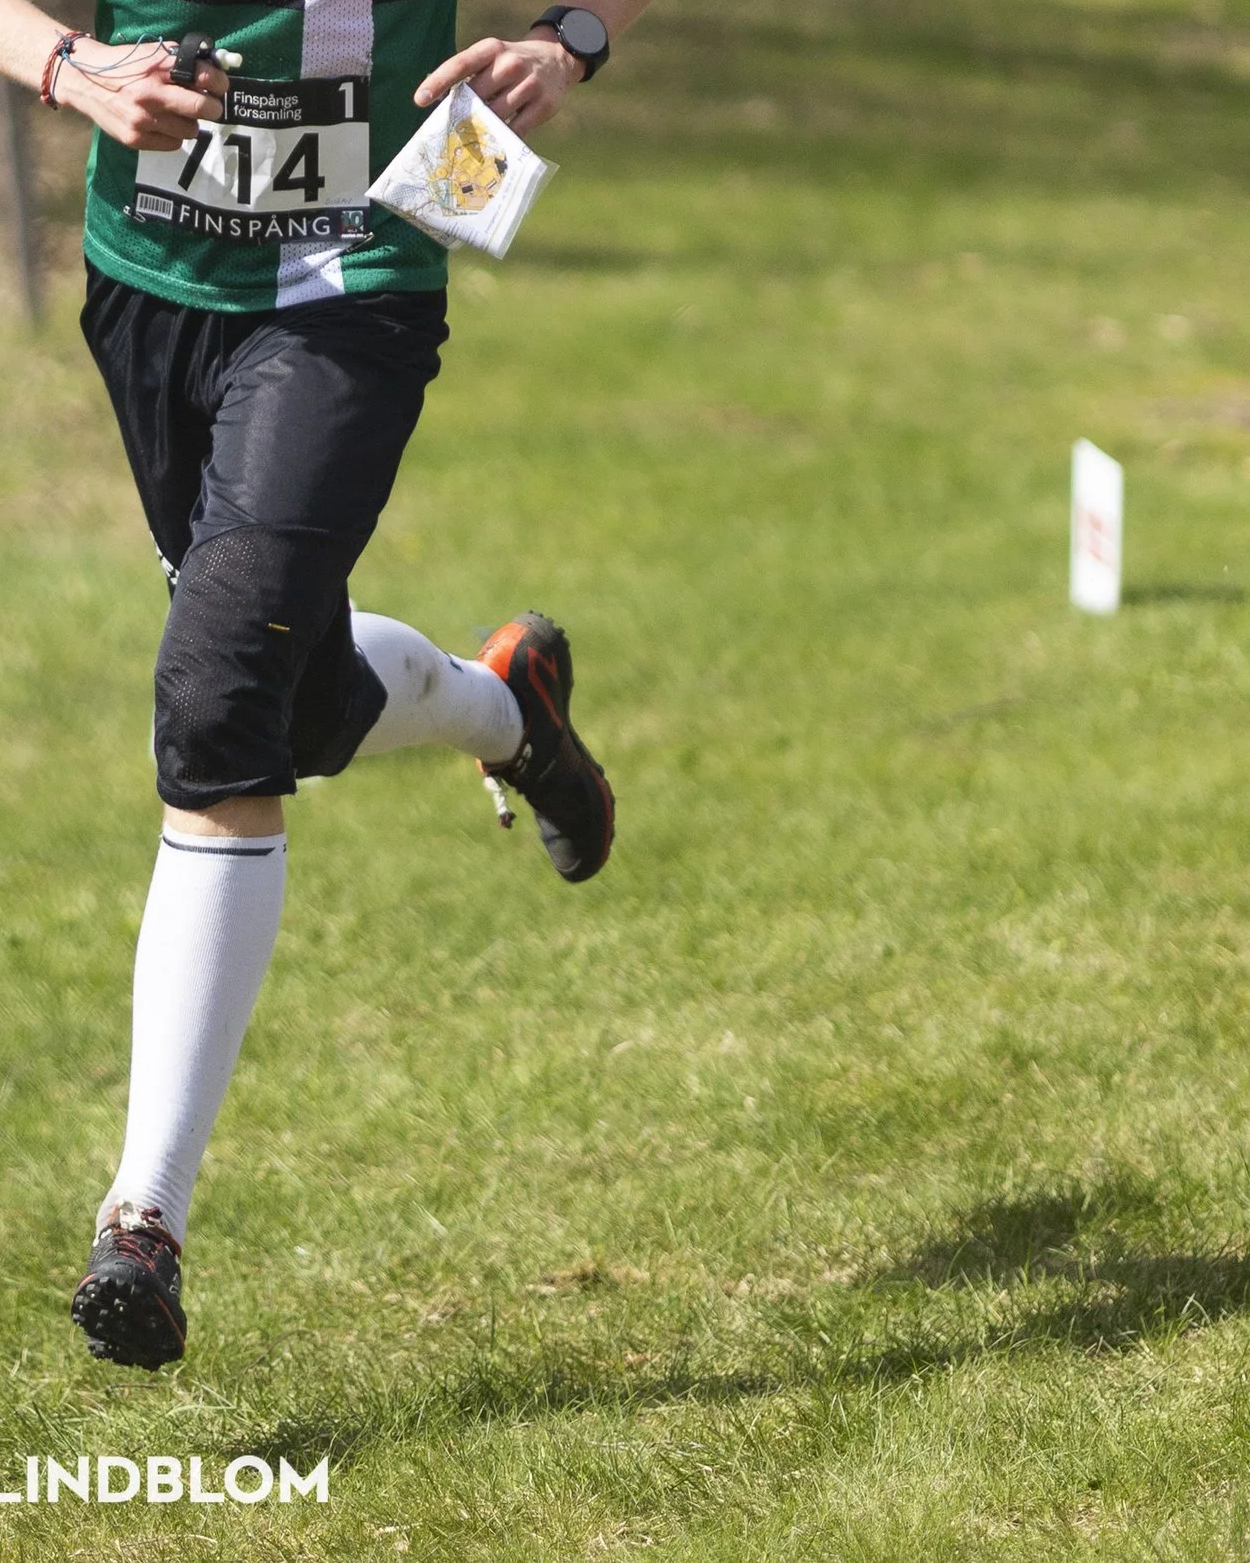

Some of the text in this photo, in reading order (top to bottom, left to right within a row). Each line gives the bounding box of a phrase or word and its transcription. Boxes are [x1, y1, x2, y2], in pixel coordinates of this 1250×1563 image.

[233, 91, 299, 109] Finspångs
[233, 104, 302, 121] församling
[338, 81, 354, 119] 1
[177, 130, 326, 205] 714
[179, 204, 331, 238] FINSPÅNG
